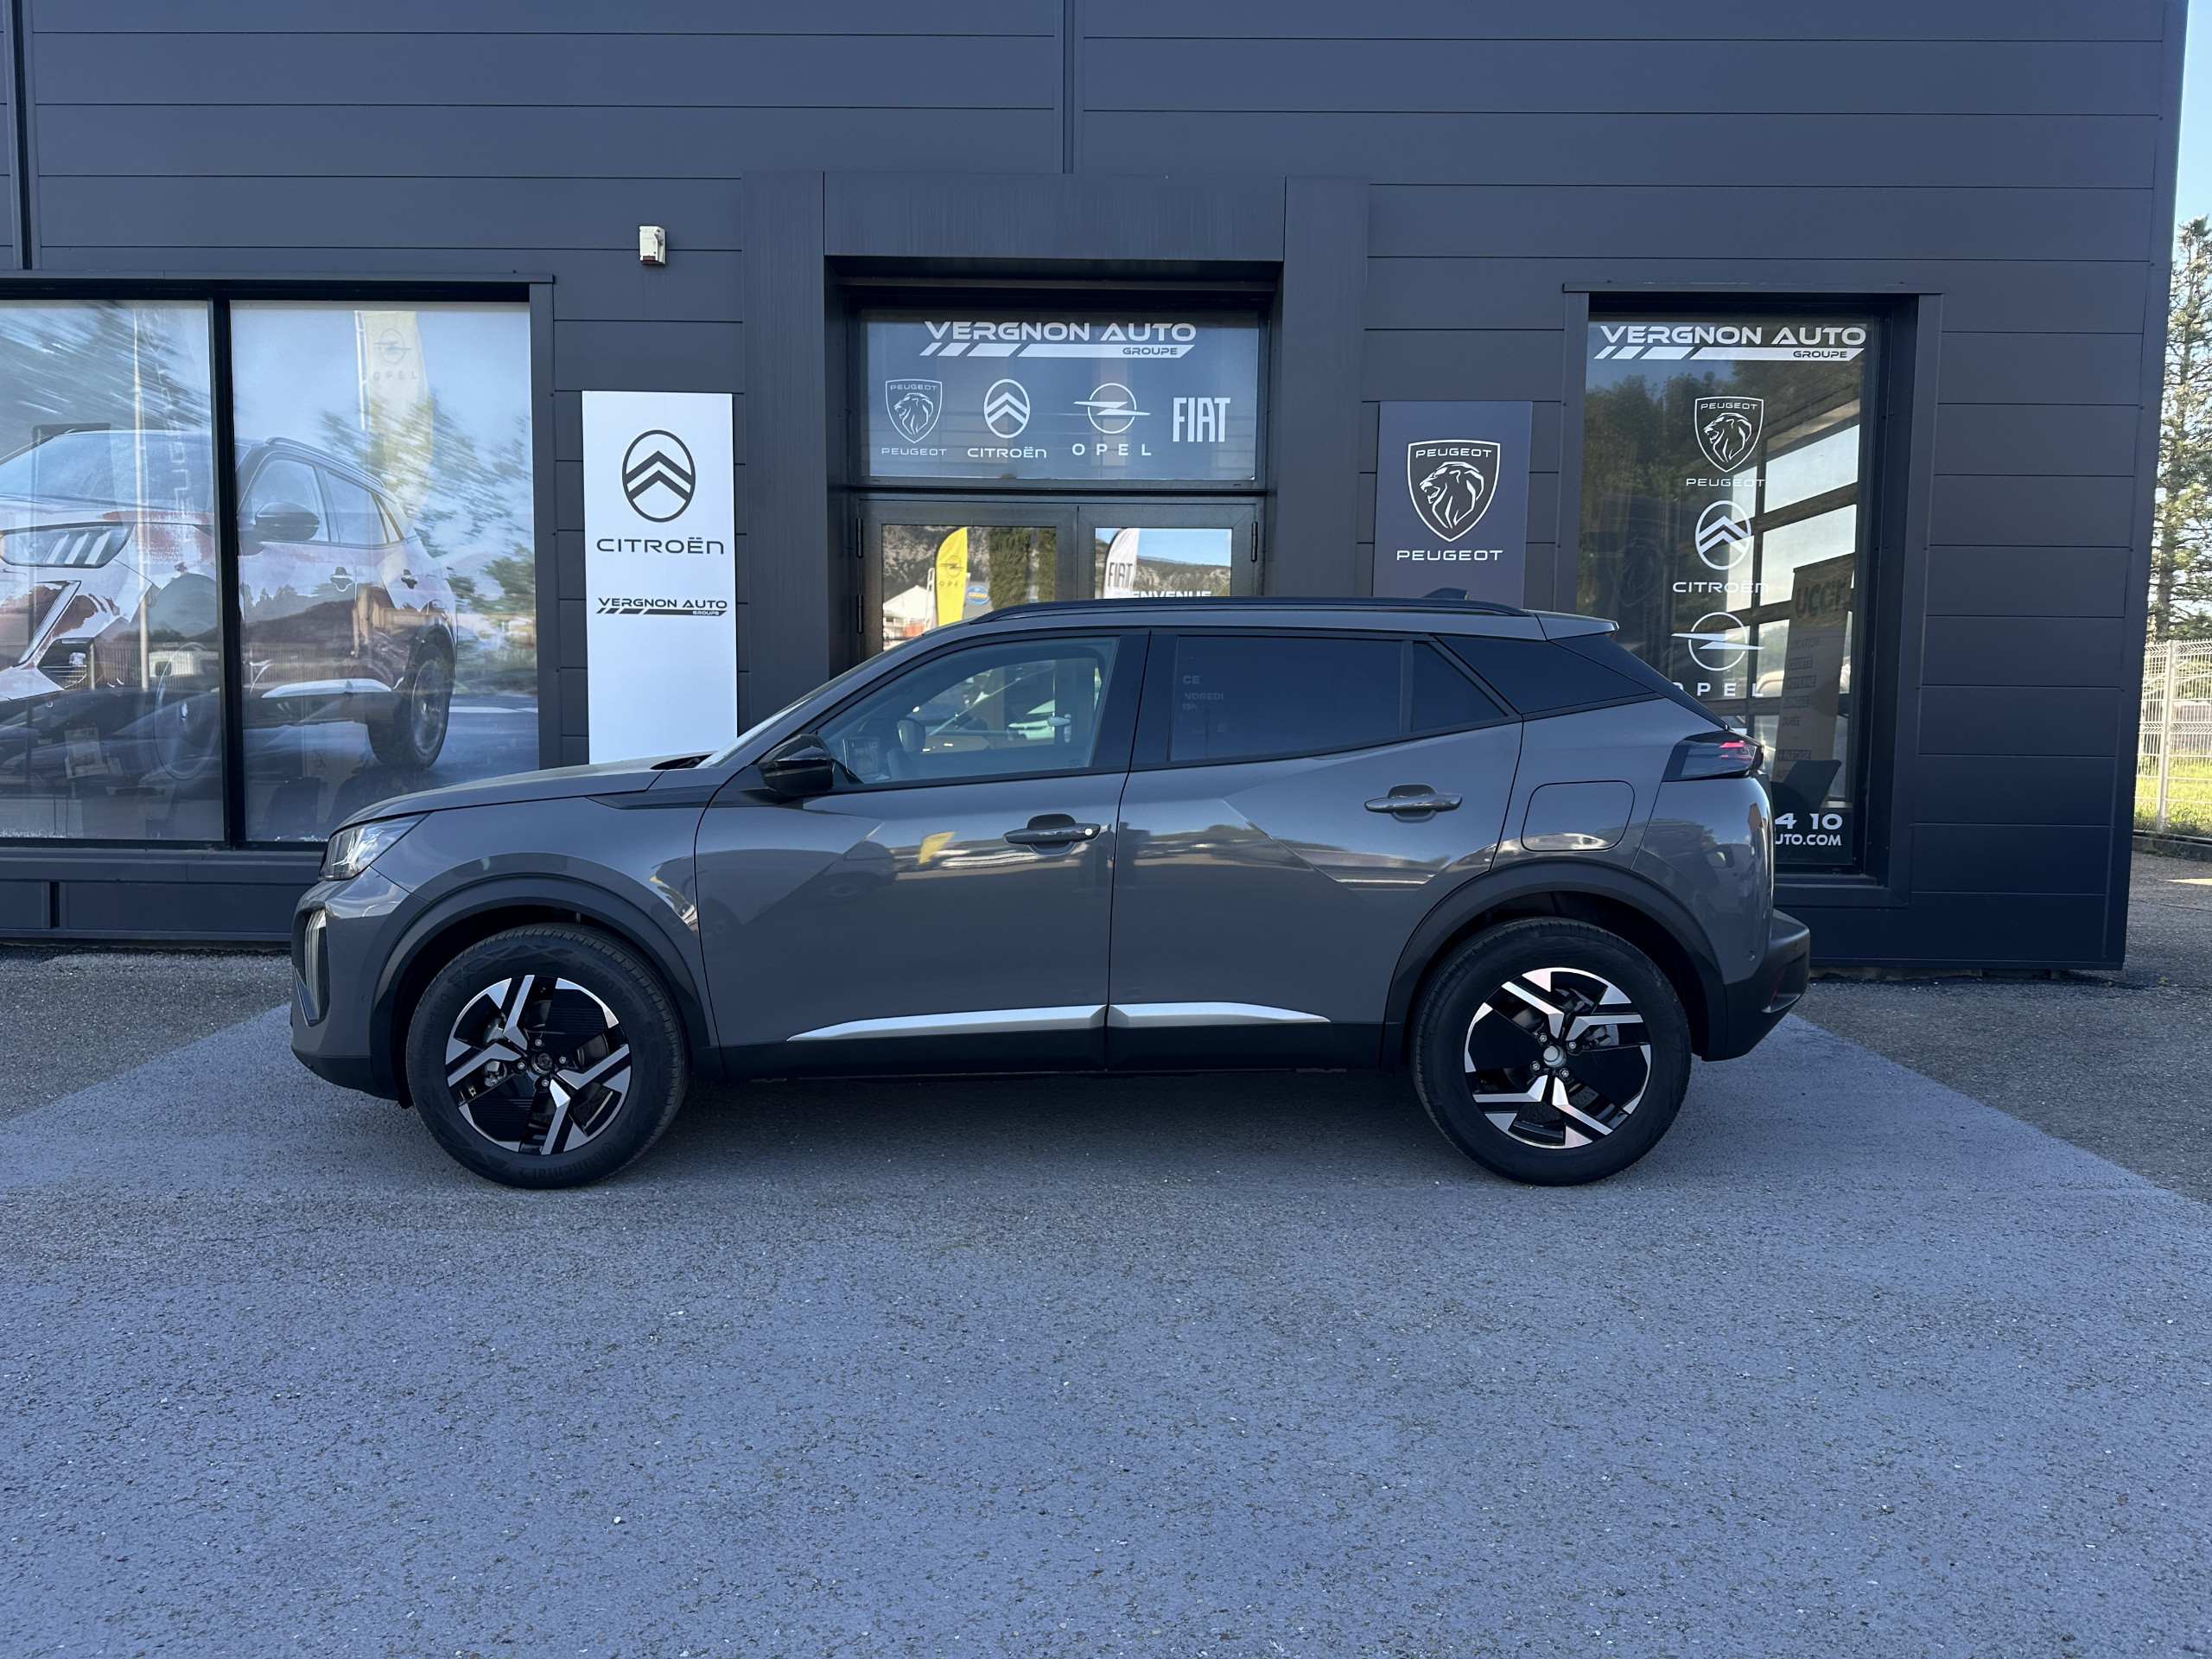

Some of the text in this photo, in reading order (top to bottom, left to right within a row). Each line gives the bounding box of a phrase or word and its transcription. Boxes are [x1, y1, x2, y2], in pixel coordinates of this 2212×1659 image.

[924, 321, 1197, 342] VERGNON AUTO
[1599, 325, 1866, 346] VERGNON AUTO
[1793, 350, 1847, 359] GROUPE
[373, 371, 416, 381] OPEL
[890, 384, 938, 392] PEUGEOT
[1700, 402, 1758, 410] PEUGEOT
[1173, 397, 1231, 443] FIAT
[881, 447, 947, 456] PEUGEOT
[967, 446, 1047, 459] CITROËN
[1071, 443, 1152, 457] OPEL
[1415, 448, 1492, 459] PEUGEOT
[1686, 478, 1765, 487] PEUGEOT
[596, 536, 725, 555] CITROËN
[1396, 550, 1503, 562] PEUGEOT
[1108, 562, 1134, 588] FIAT
[1672, 580, 1770, 594] CITROËN
[598, 596, 728, 609] VERGNON AUTO
[1809, 813, 1843, 830] 10
